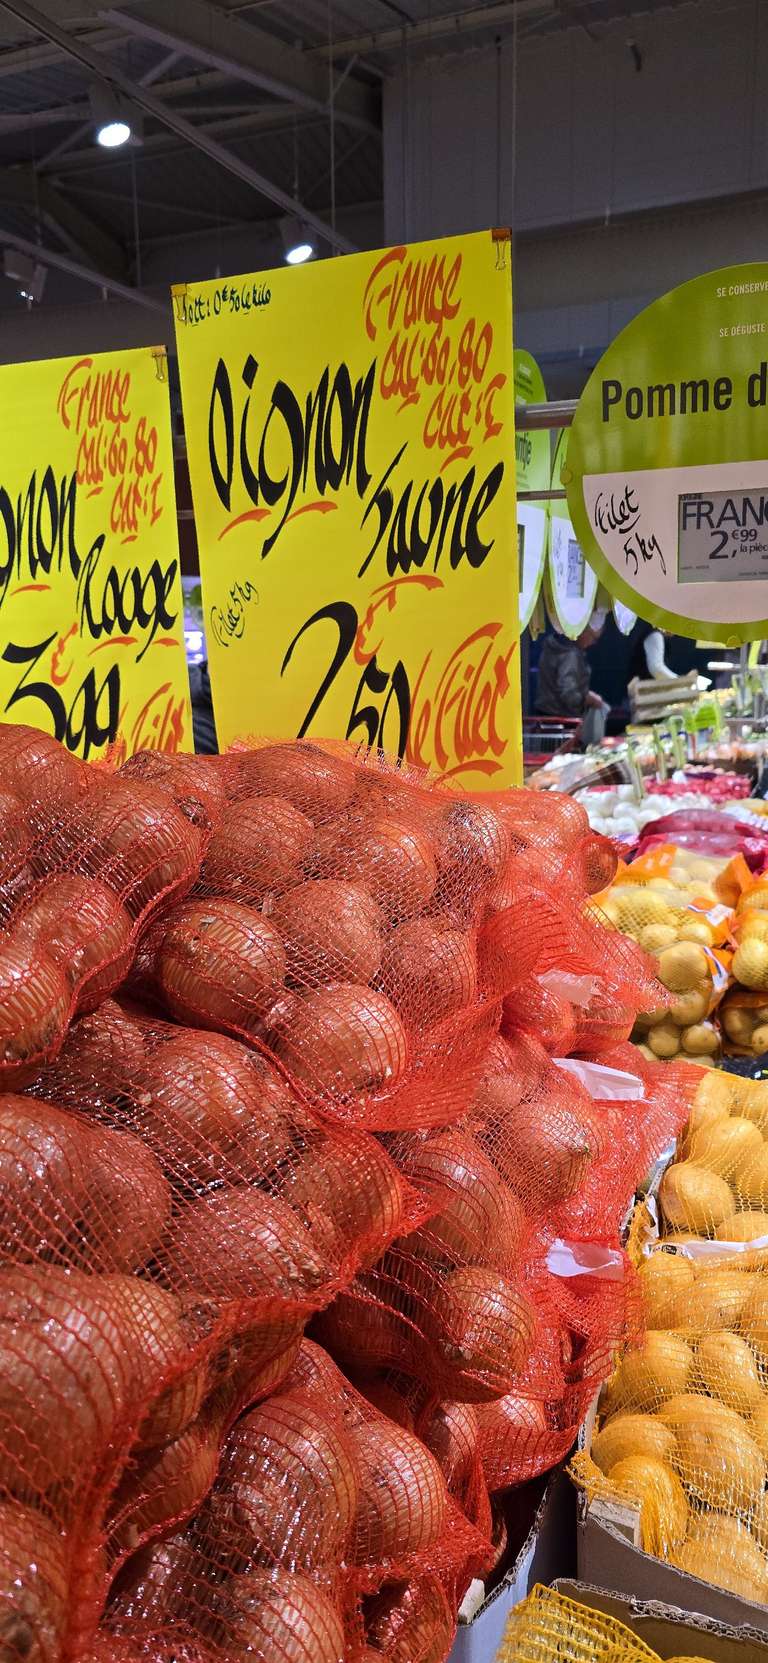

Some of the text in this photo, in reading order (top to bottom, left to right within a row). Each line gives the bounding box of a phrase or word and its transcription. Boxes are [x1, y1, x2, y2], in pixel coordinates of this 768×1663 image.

[363, 245, 463, 342] France
[716, 287, 727, 297] SE
[719, 322, 766, 338] SE DÉGUSTE
[57, 357, 132, 435] France
[602, 379, 733, 423] Pomme
[208, 353, 378, 560] Oignon
[595, 484, 639, 534] Filet
[682, 495, 768, 531] FRAN
[77, 533, 178, 664] Rouge
